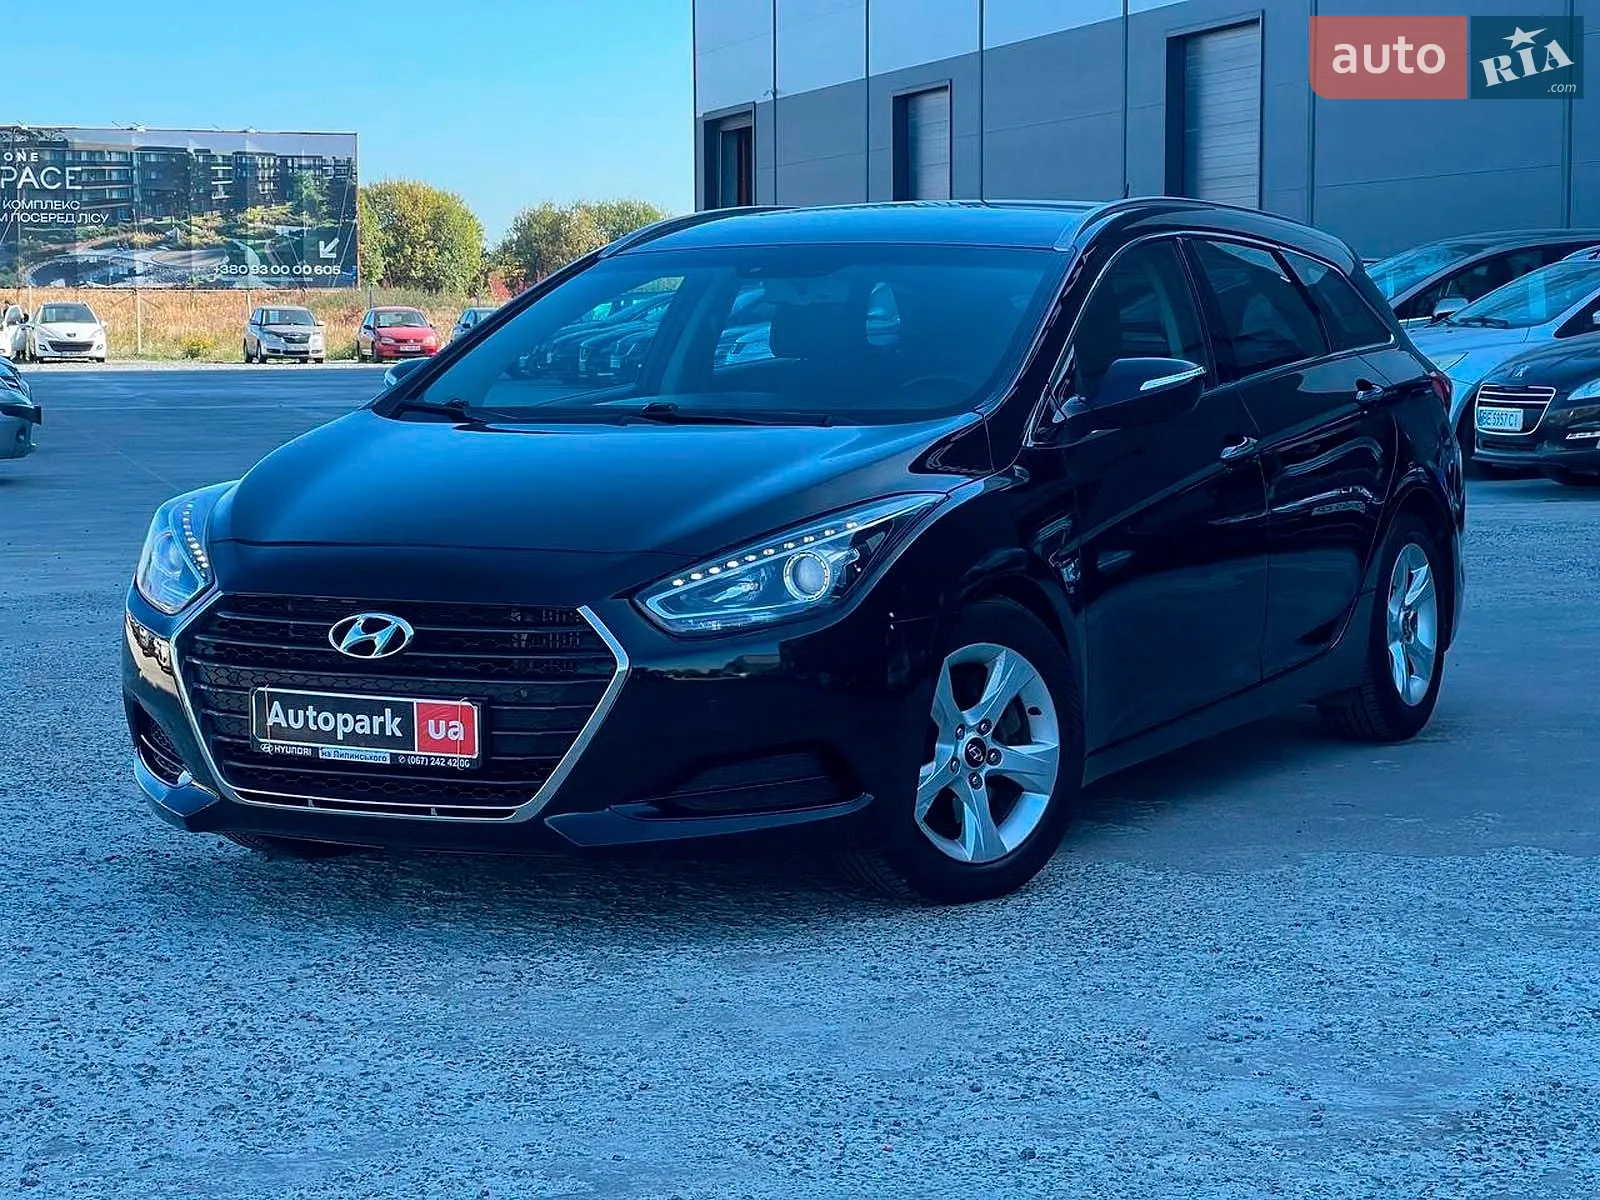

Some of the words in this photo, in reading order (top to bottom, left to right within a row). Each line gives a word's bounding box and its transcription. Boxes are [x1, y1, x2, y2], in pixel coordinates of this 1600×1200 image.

[3, 151, 39, 162] ONE
[0, 166, 82, 190] PACE
[3, 200, 80, 211] КОМПЛЕКС
[11, 212, 76, 224] ПОСЕРЕД
[78, 213, 109, 225] ЛІСУ
[251, 265, 269, 276] 93
[271, 265, 290, 276] 00
[292, 265, 312, 276] 00
[314, 265, 341, 276] 605
[267, 701, 403, 740] Autopark
[428, 719, 465, 741] ua
